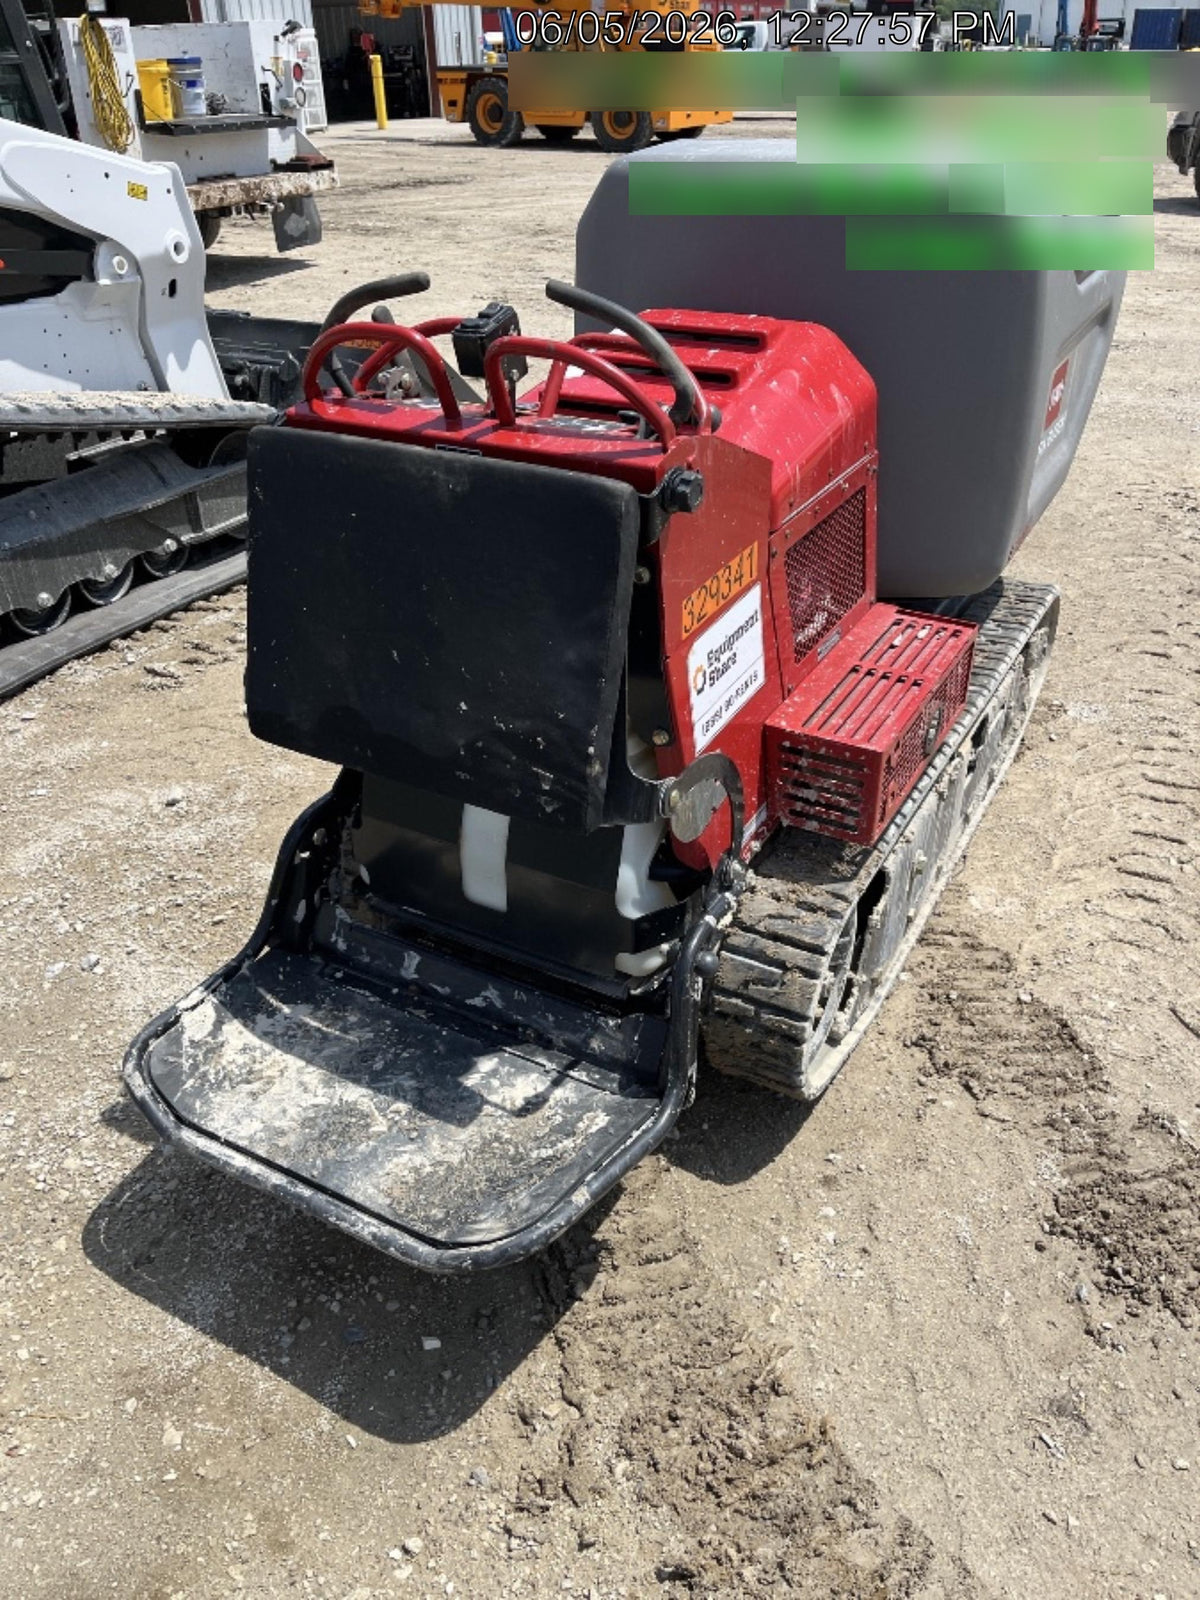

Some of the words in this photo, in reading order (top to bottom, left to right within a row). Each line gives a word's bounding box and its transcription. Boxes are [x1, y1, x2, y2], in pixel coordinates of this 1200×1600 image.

[683, 545, 757, 634] 329341
[706, 610, 760, 668] Equipment
[708, 652, 737, 688] Share
